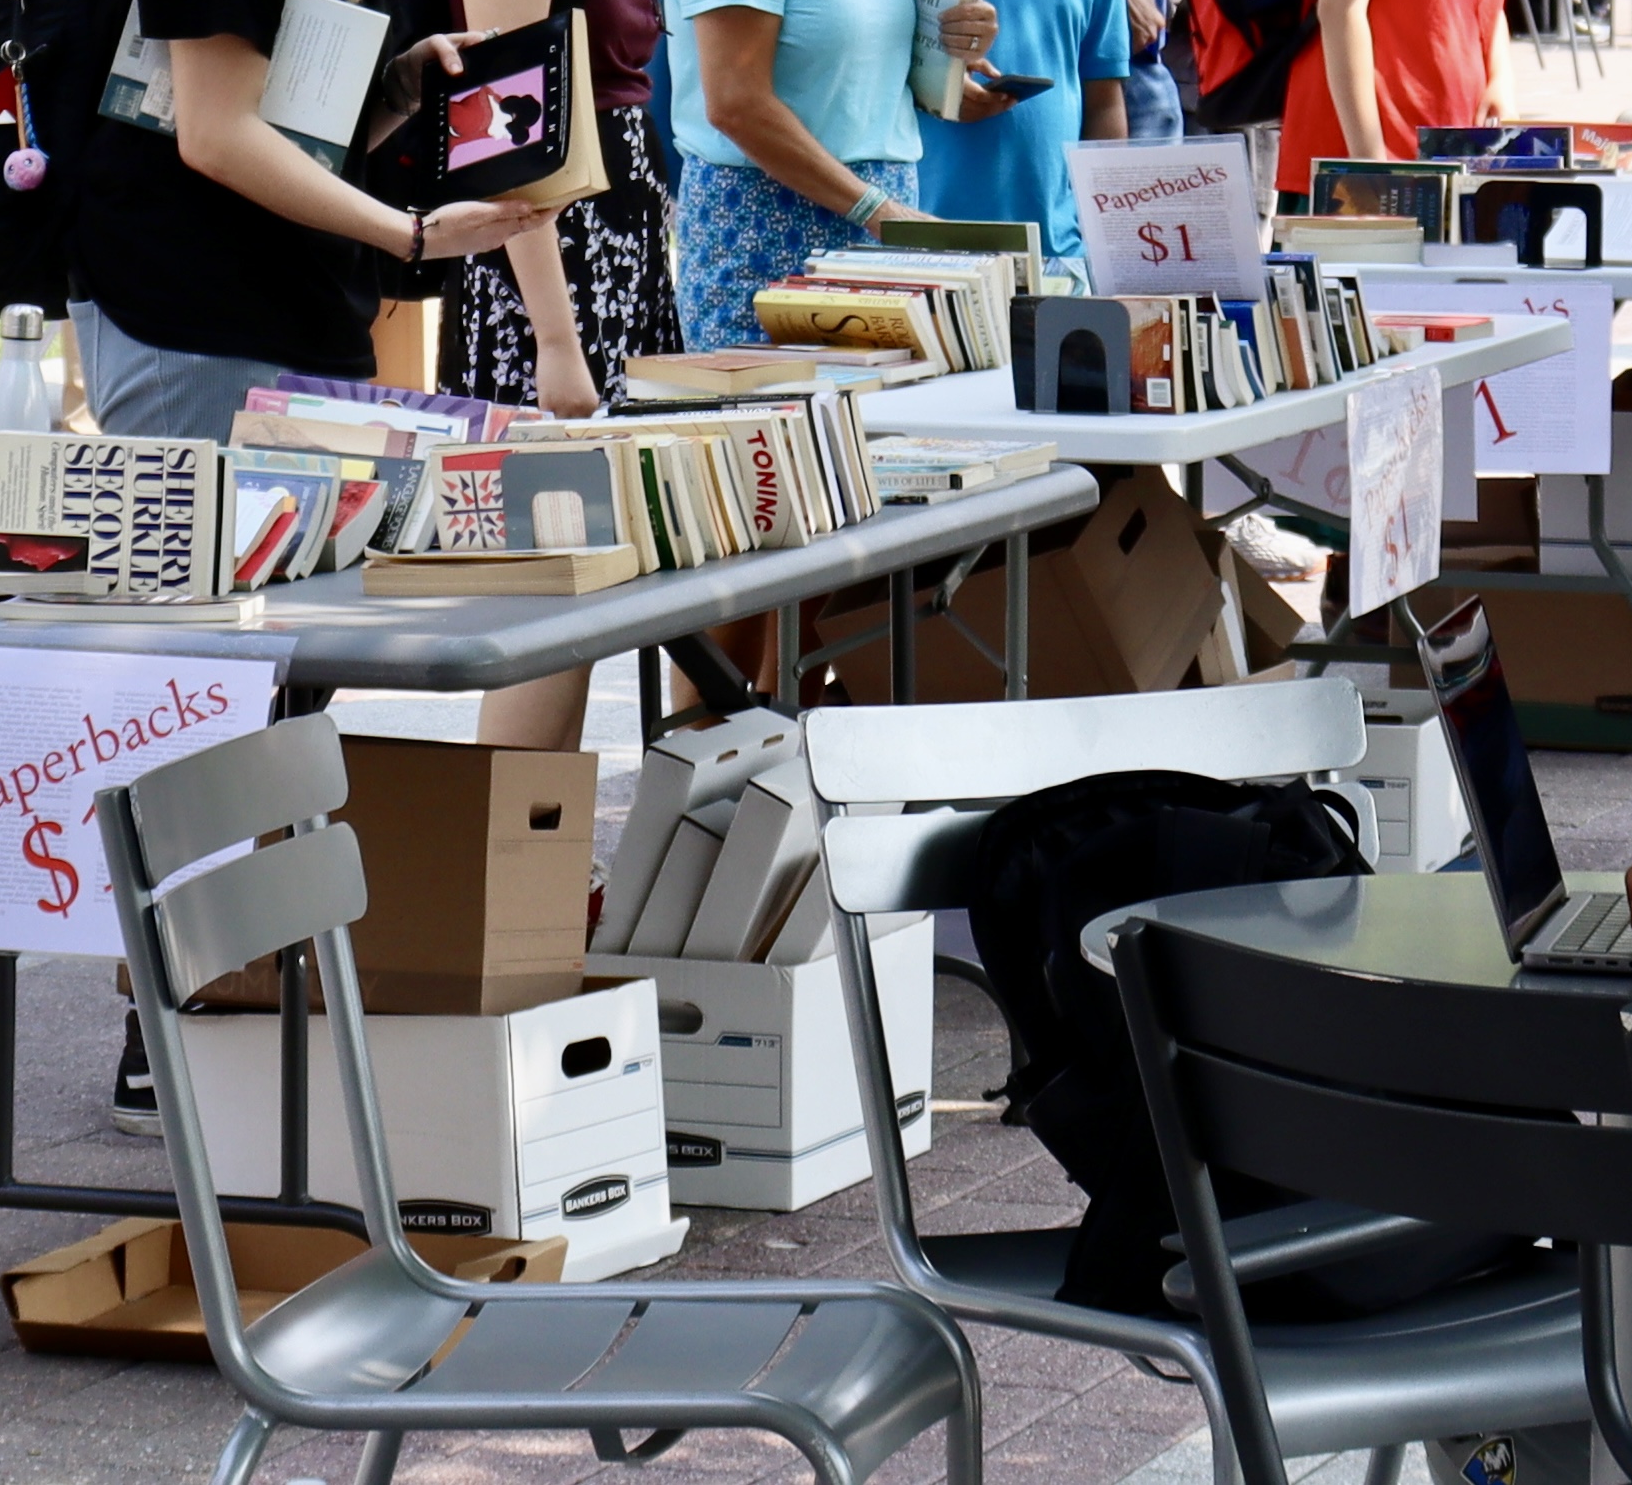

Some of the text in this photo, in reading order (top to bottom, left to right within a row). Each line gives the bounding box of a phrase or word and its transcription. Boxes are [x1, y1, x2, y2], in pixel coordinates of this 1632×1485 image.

[546, 45, 557, 153] GEISHA
[1093, 167, 1228, 213] Paperbacks
[1137, 222, 1199, 267] $1
[1475, 380, 1517, 445] 1
[47, 441, 61, 532] Computers and the
[61, 444, 94, 537] SELF
[746, 429, 781, 533] TONING
[901, 477, 912, 486] OF
[1365, 385, 1429, 530] Paperbacks
[37, 464, 51, 531] Human Spirit
[129, 448, 165, 593] TURKLE
[161, 448, 196, 594] SHERRY
[681, 1145, 714, 1158] BOX
[401, 1213, 482, 1227] NKERS BOX
[566, 1185, 627, 1213] BANKERS BOX
